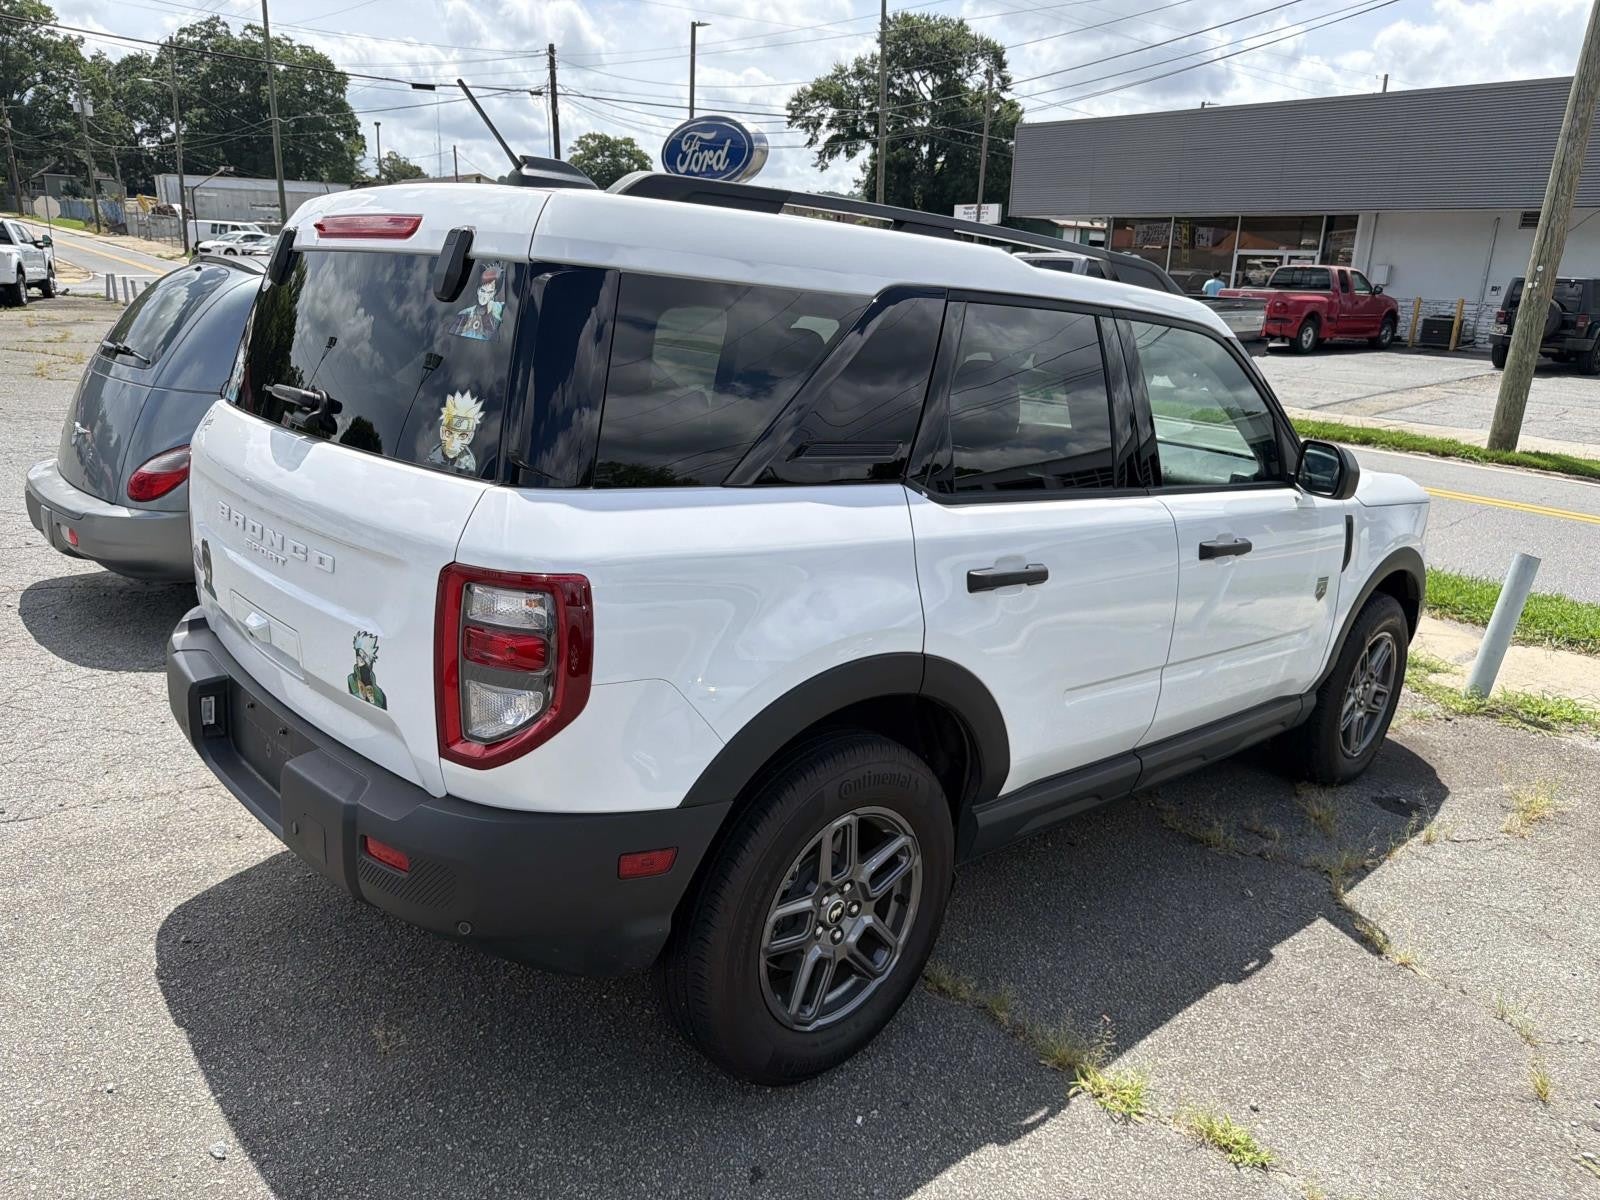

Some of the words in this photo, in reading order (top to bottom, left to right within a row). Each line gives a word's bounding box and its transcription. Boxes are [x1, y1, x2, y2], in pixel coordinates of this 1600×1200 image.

[677, 130, 731, 173] Ford
[218, 500, 335, 574] BRONCO
[245, 537, 288, 566] SPORT
[838, 770, 912, 799] Continental
